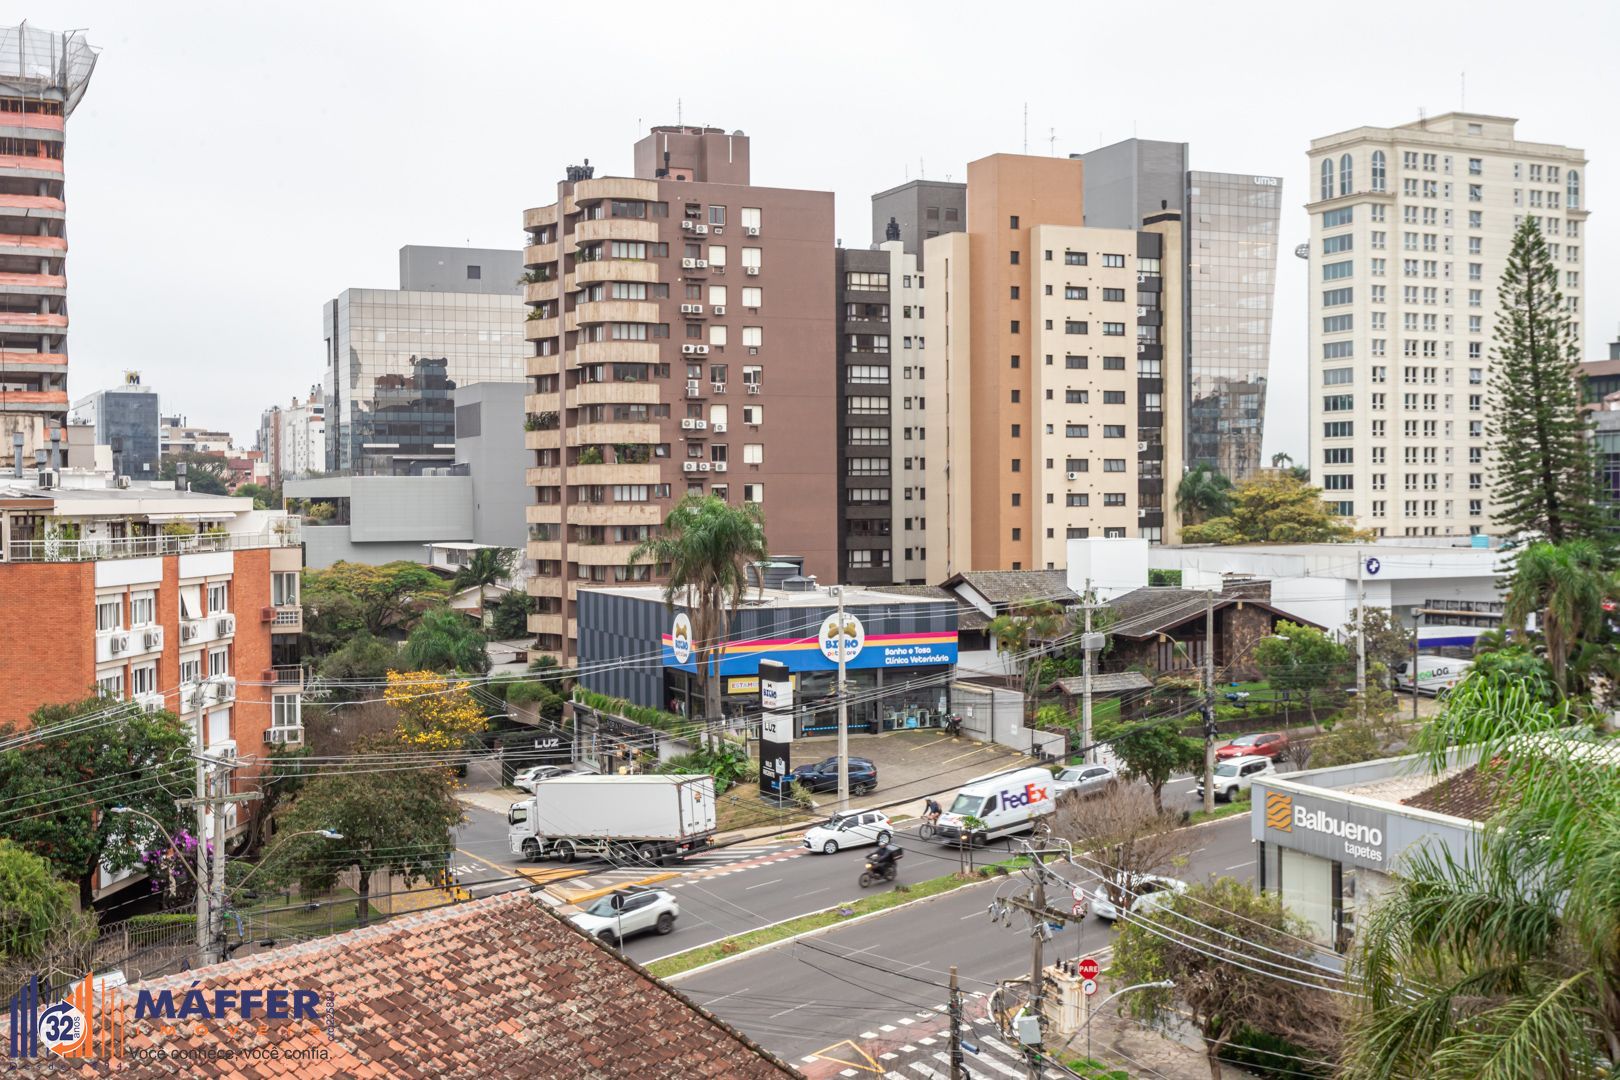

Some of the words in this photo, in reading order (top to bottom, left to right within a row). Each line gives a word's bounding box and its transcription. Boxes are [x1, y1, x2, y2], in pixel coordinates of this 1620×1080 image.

[1254, 177, 1277, 186] uma
[825, 639, 859, 649] BIHO
[885, 647, 907, 655] Banho
[914, 646, 931, 654] Tosa
[885, 656, 909, 665] Clínica
[910, 654, 949, 664] Veterinária
[765, 721, 776, 733] LUZ
[534, 738, 559, 749] LUZ
[1000, 783, 1049, 811] FedEx
[1294, 805, 1383, 846] Balbueno
[1344, 840, 1383, 862] tapetes
[1080, 965, 1098, 973] PARE
